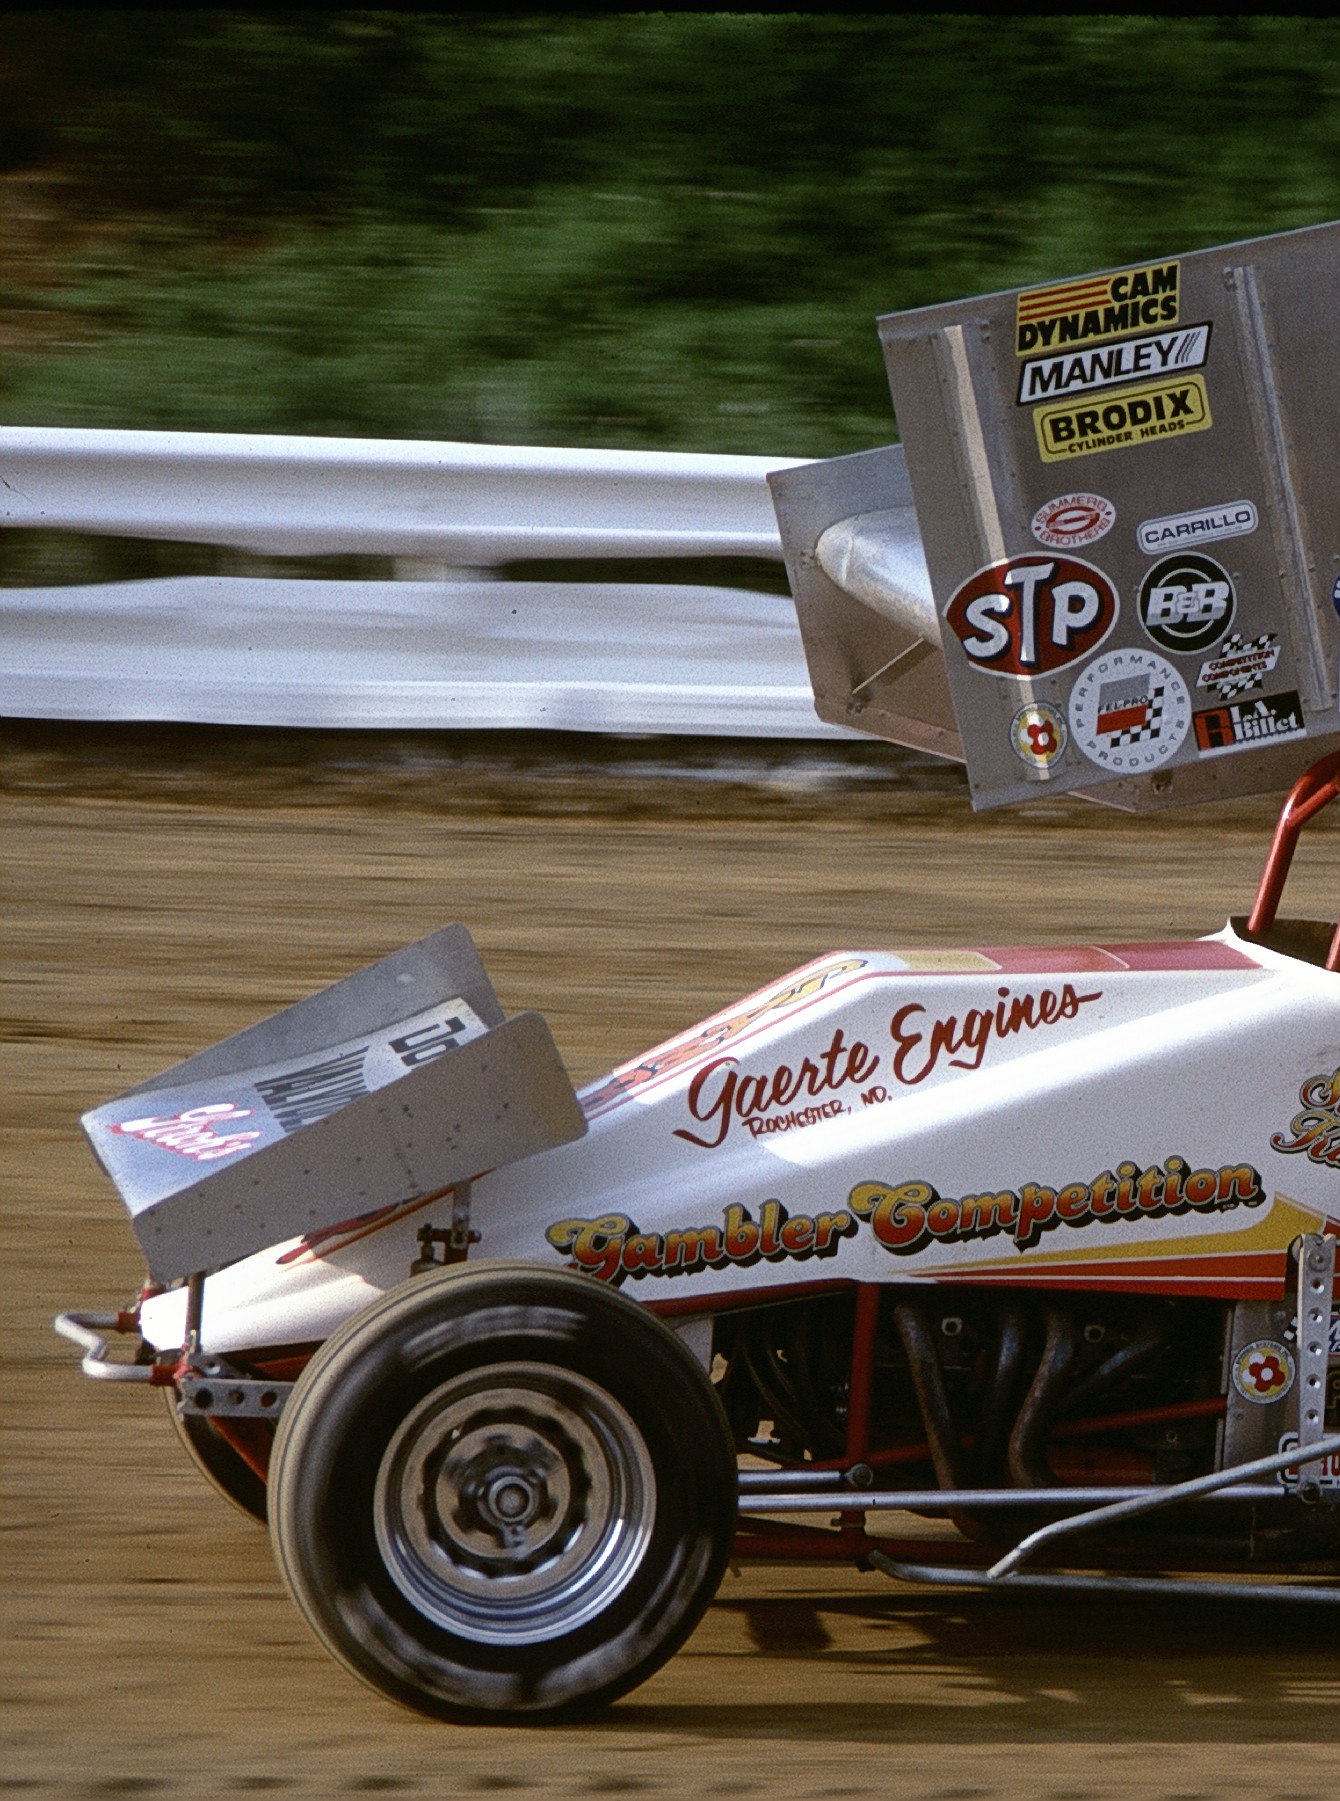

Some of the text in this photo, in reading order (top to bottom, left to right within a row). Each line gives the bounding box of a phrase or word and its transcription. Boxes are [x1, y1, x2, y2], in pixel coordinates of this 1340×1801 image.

[1109, 265, 1177, 303] CAM
[1018, 296, 1177, 352] DYNAMICS
[1029, 336, 1178, 396] MANLEY
[1049, 388, 1194, 443] BRODIX
[1067, 419, 1185, 454] CYLINDER HEADS
[1145, 510, 1251, 543] CARRILLO
[963, 562, 1100, 666] STP
[1075, 655, 1185, 728] PERFORMANCE
[1087, 720, 1185, 767] PRODUCTS
[672, 984, 1103, 1148] Gaerte Engines
[742, 1101, 852, 1139] ROCHESTER,
[545, 1155, 1267, 1287] Gambler Competition
